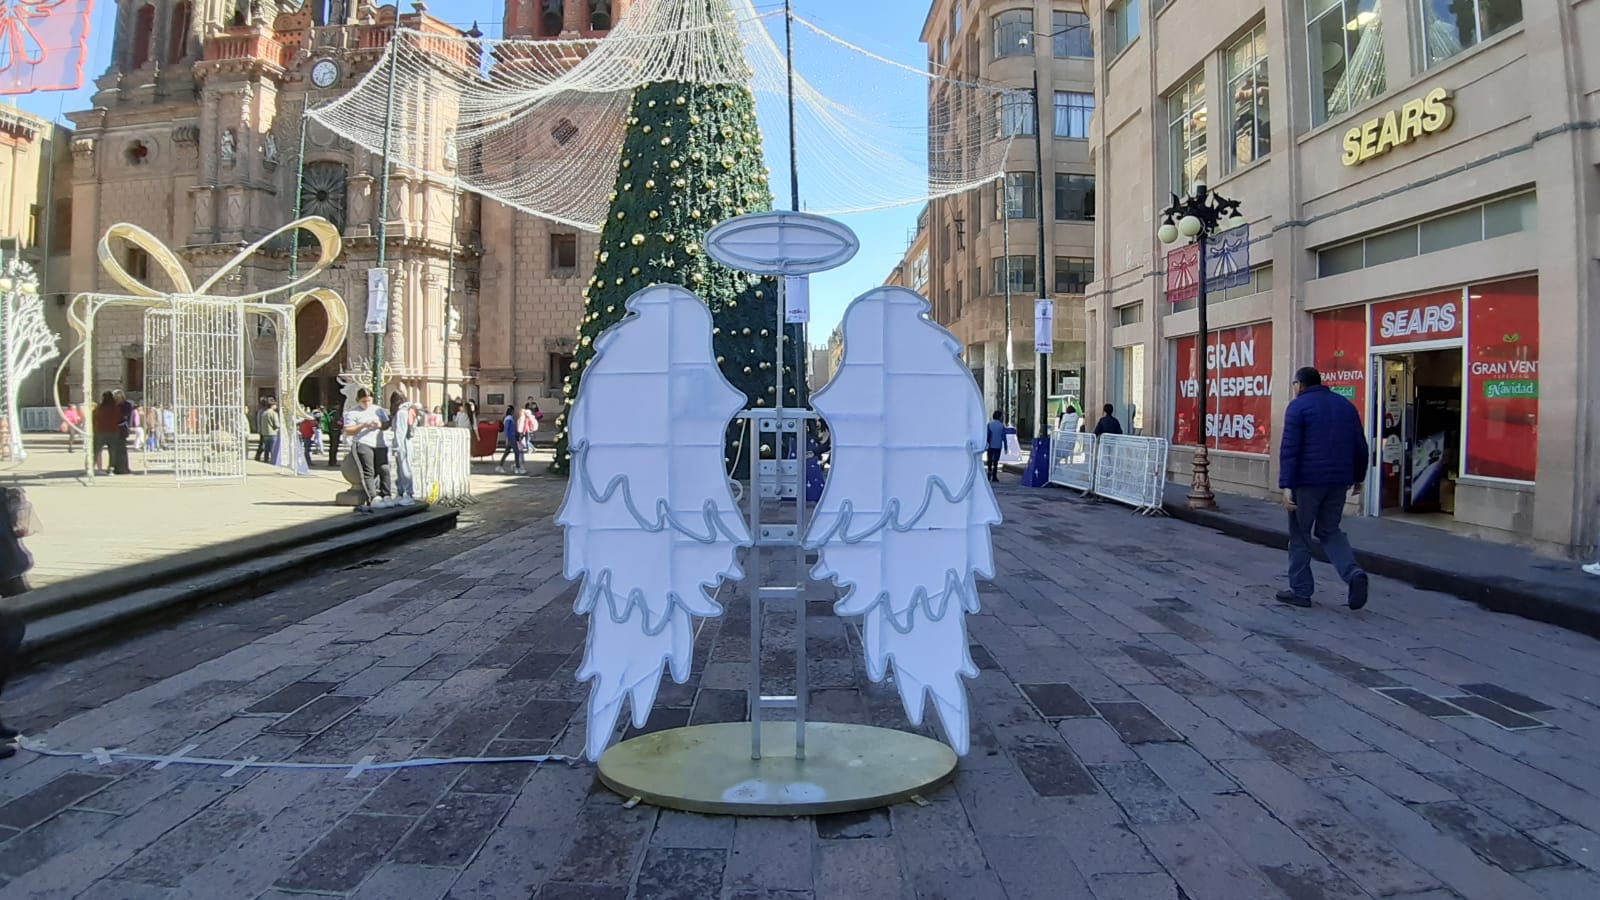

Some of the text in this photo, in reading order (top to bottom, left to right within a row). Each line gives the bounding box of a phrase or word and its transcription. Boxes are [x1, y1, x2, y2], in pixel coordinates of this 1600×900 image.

[1342, 87, 1450, 166] SEARS
[1380, 303, 1456, 338] SEARS
[1206, 340, 1254, 370] GRAN
[1319, 370, 1364, 382] RAN VENTA
[1471, 362, 1507, 375] GRAN
[1487, 381, 1534, 398] Navidad
[1206, 413, 1255, 439] SEARS
